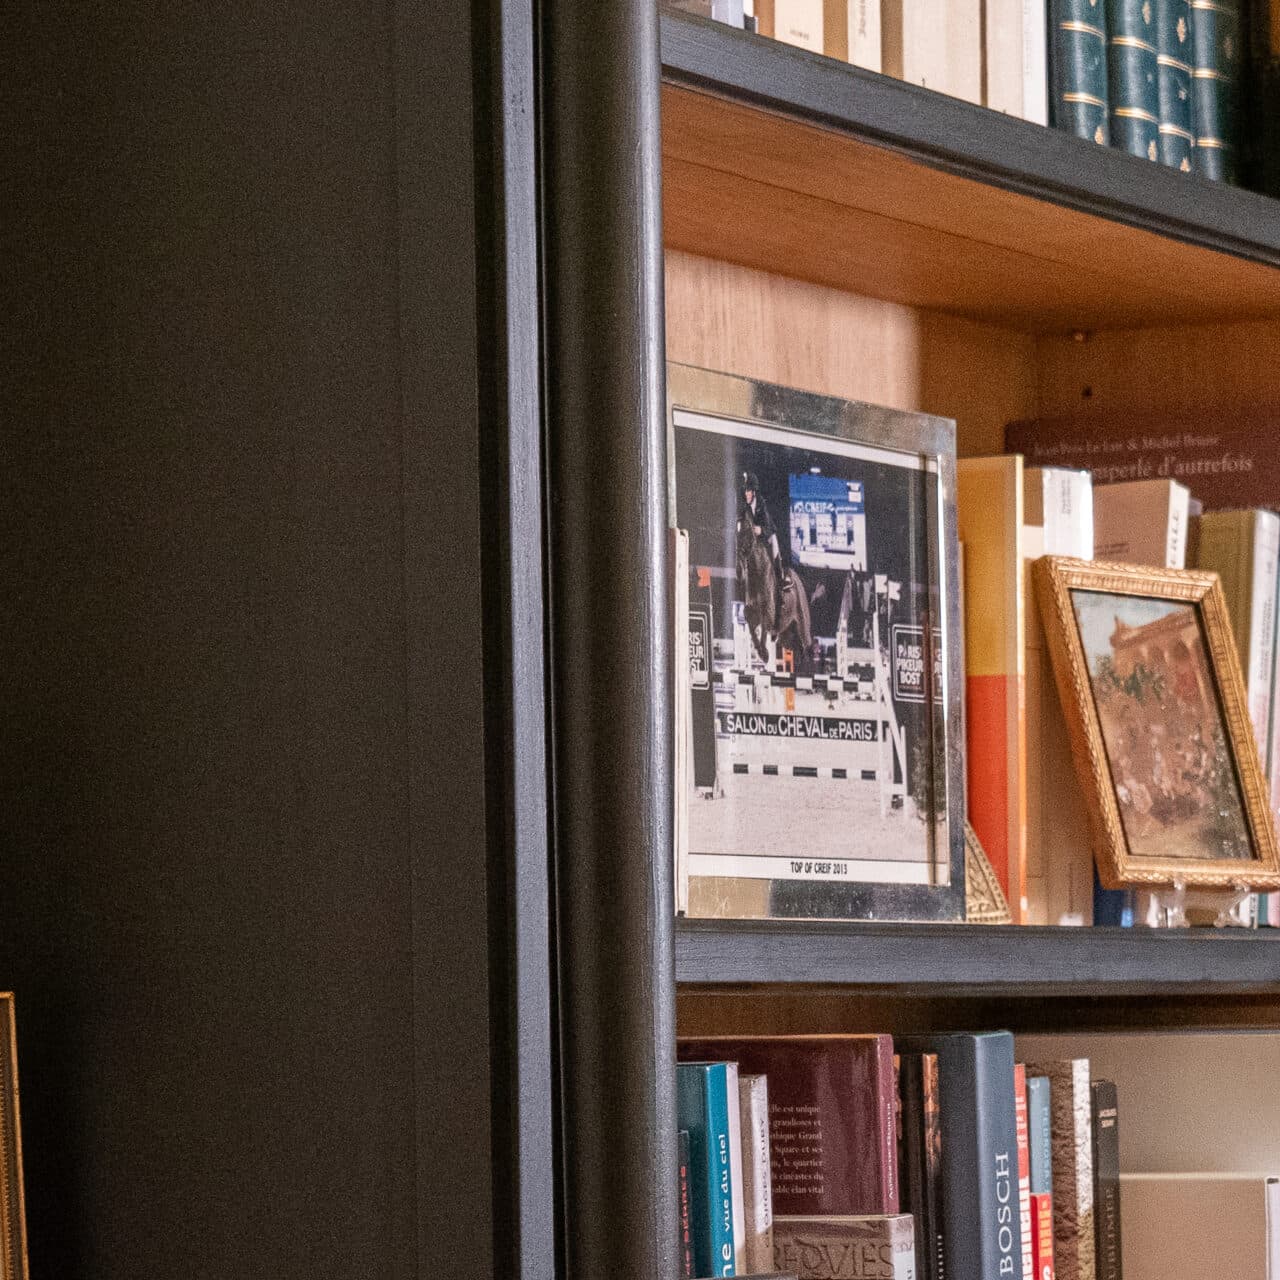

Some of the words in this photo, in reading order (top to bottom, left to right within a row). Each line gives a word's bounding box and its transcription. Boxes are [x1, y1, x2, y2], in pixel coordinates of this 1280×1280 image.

[1157, 451, 1253, 478] d'autrefois
[726, 714, 767, 734] SALON
[778, 715, 828, 738] CHEVAL
[839, 721, 872, 740] PARIS
[790, 861, 803, 873] TOP
[804, 862, 813, 873] OF
[718, 1134, 728, 1165] ciel
[721, 1170, 730, 1193] du
[996, 1151, 1016, 1274] BOSCH
